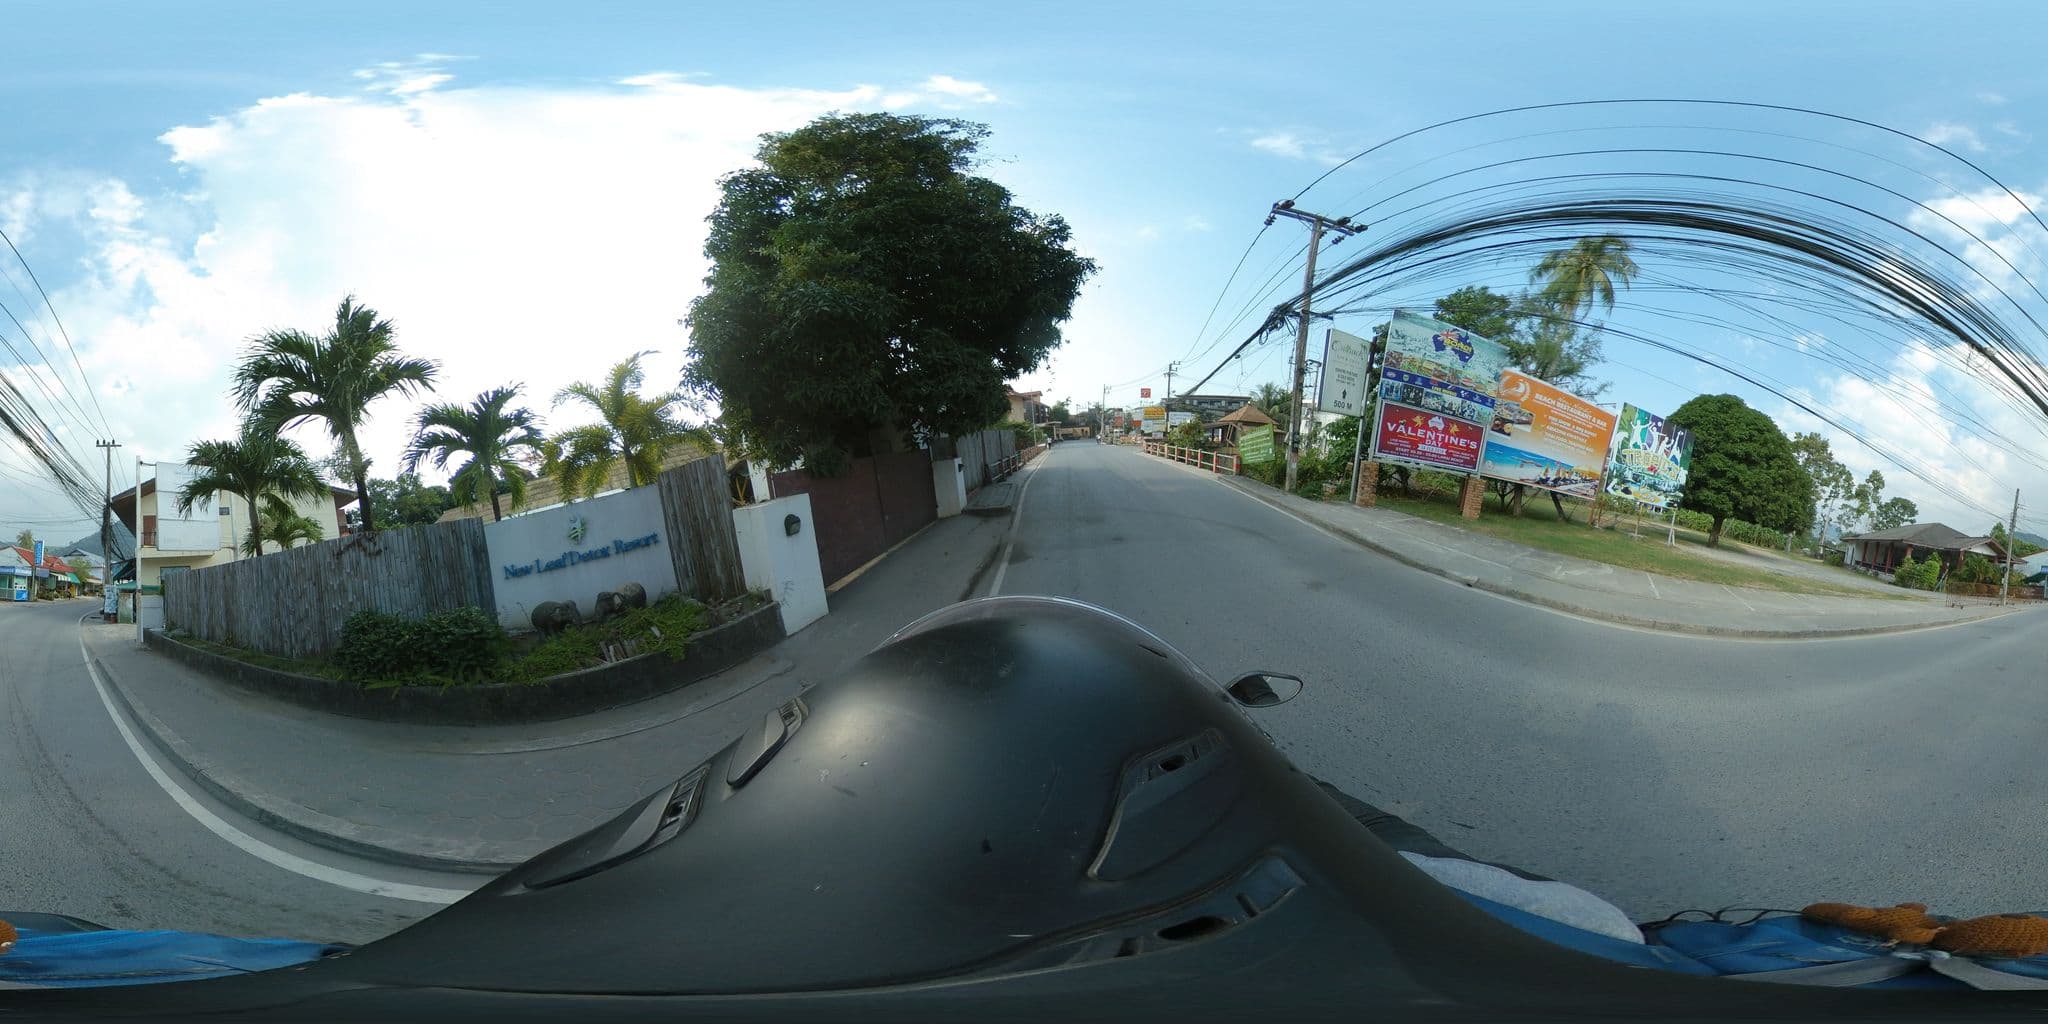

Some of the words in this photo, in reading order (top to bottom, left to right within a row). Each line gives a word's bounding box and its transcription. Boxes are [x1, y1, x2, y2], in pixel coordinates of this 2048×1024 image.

[1333, 400, 1346, 409] 500
[1386, 422, 1478, 449] VALENTINE'S
[503, 564, 533, 580] New
[534, 552, 567, 574] Leaf
[566, 546, 611, 566] Detox
[613, 532, 659, 554] Resort
